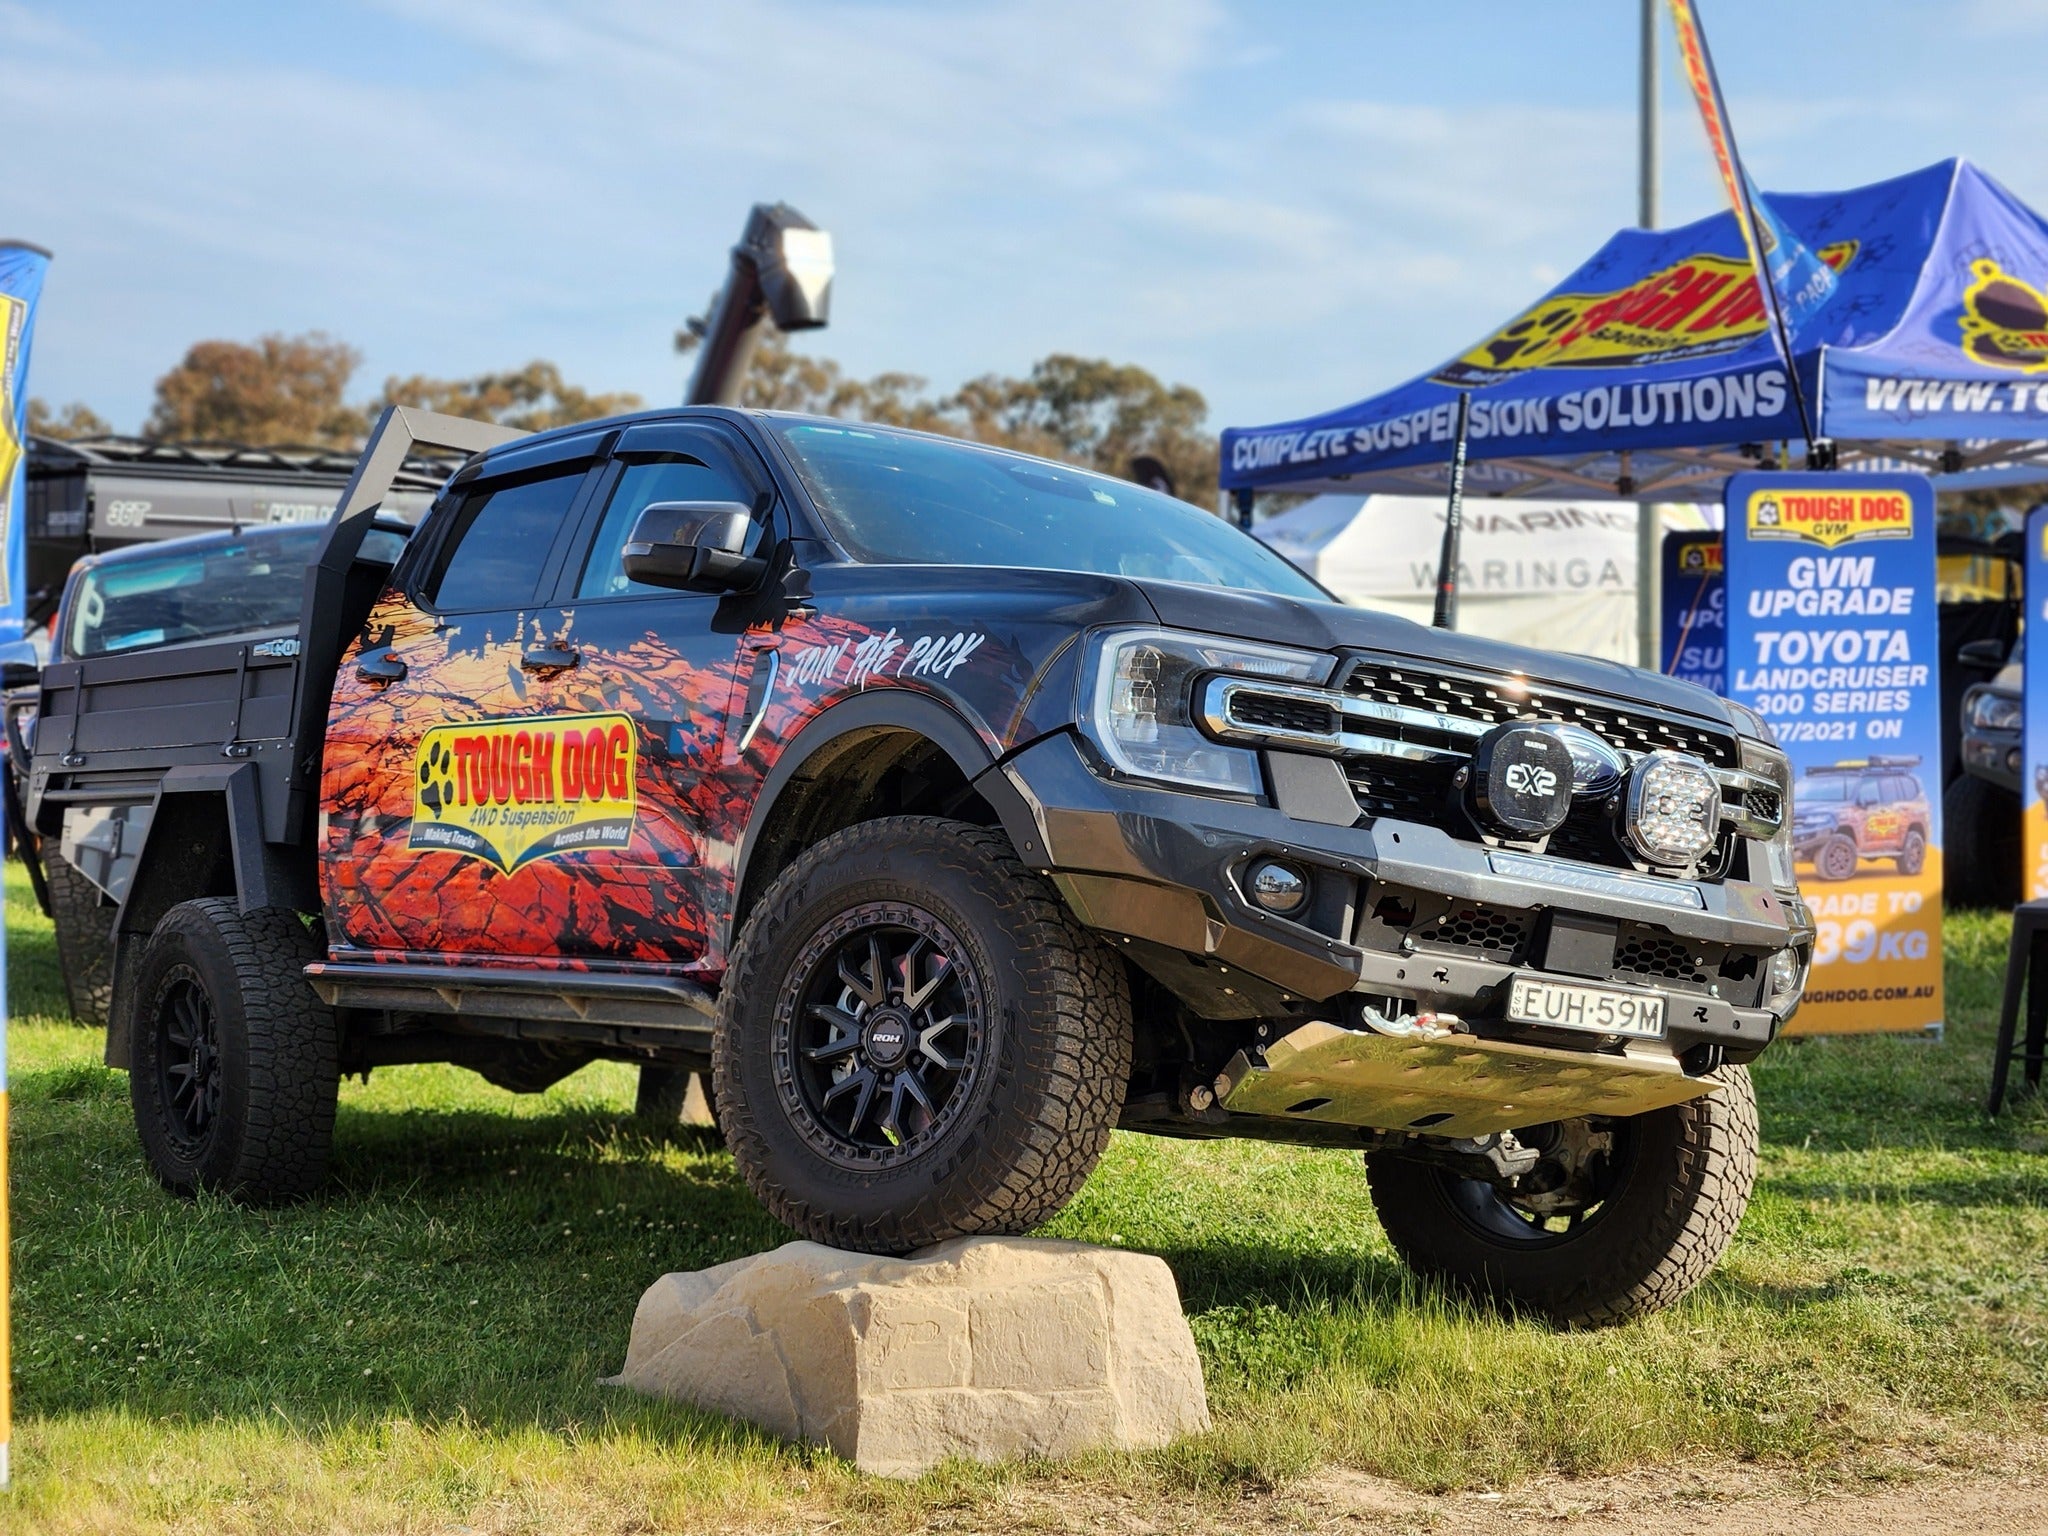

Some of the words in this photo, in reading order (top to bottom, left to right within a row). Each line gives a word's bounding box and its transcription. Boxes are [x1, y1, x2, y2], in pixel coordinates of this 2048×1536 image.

[1233, 428, 1348, 471] COMPLETE
[1354, 397, 1549, 454] SUSPENSION
[1559, 370, 1788, 431] SOLUTIONS
[1782, 497, 1855, 522] TOUGH
[1860, 496, 1905, 521] DOG
[1813, 523, 1849, 536] GVM
[1410, 557, 1623, 589] WARINGA
[1788, 556, 1875, 589] GVM
[1748, 588, 1914, 617] UPGRADE
[786, 637, 851, 688] JOIN
[844, 626, 905, 692] THE
[897, 632, 985, 679] PACK
[1754, 630, 1911, 664] TOYOTA
[1735, 665, 1929, 691] LANDCRUISER
[1754, 694, 1805, 716] 300
[1812, 690, 1911, 714] SERIES
[1866, 719, 1903, 740] ON
[453, 730, 556, 807] TOUGH
[561, 724, 629, 804] DOG
[1506, 763, 1557, 797] EX2
[469, 808, 498, 826] 4WD
[500, 805, 576, 829] Suspension
[452, 830, 477, 849] Tracks
[553, 829, 583, 848] Across
[585, 827, 599, 841] the
[601, 826, 629, 842] World
[1806, 893, 1877, 917] RADE
[1888, 891, 1923, 914] TO
[1801, 986, 1935, 1004] UGHDOG.COM.AU
[872, 1033, 901, 1043] ROH
